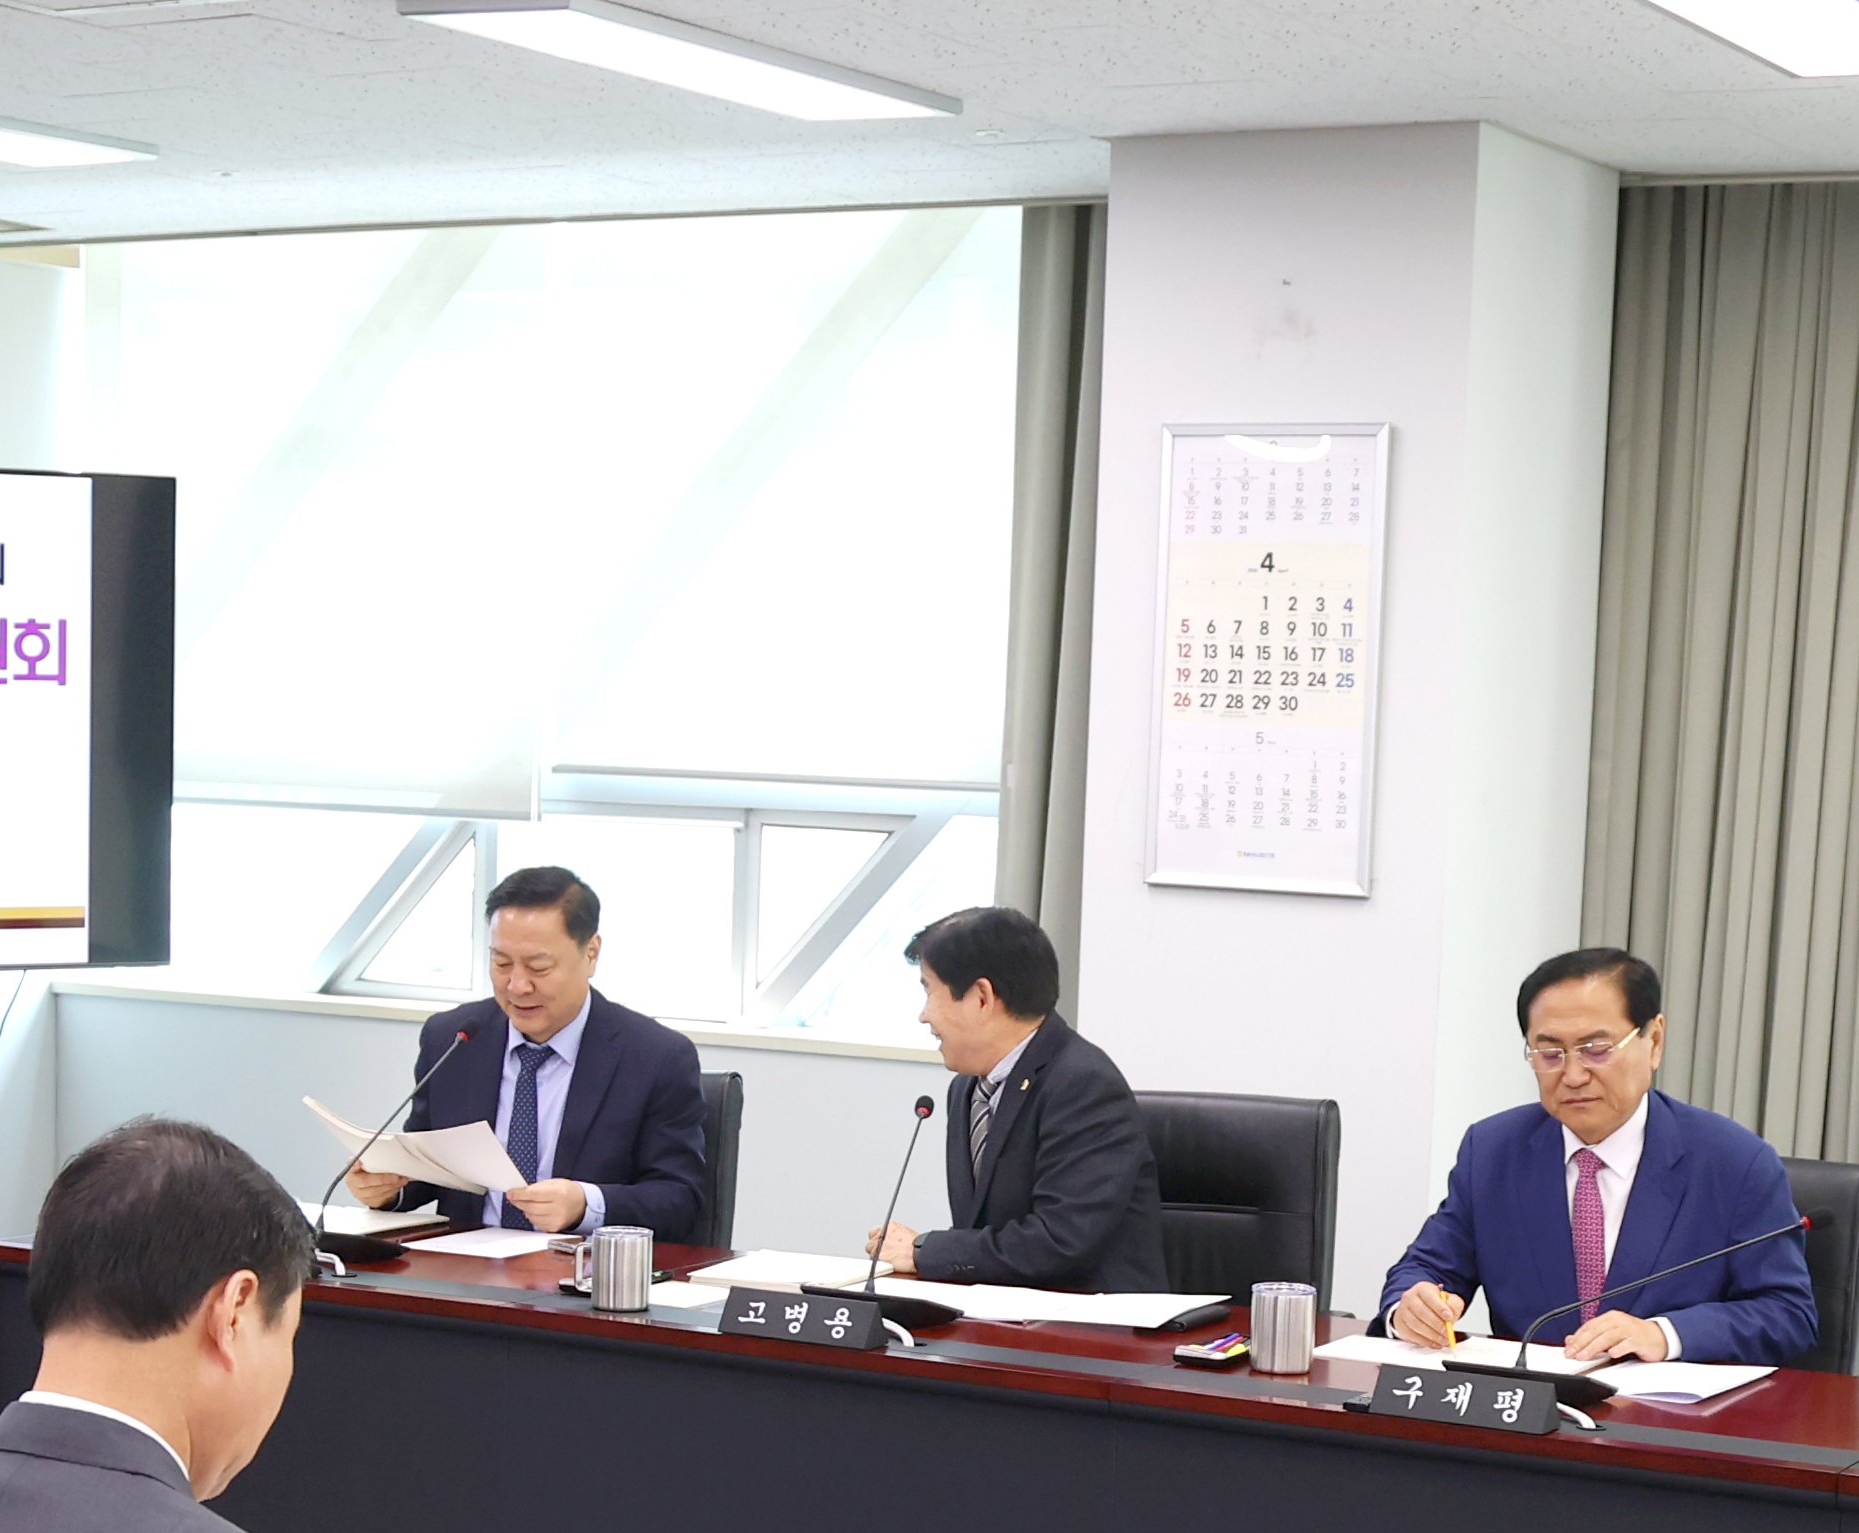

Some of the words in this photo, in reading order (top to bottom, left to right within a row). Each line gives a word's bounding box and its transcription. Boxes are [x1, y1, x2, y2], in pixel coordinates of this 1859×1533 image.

[1191, 468, 1194, 476] 1
[1216, 468, 1222, 476] 2
[1243, 468, 1248, 476] 3
[1270, 468, 1275, 476] 4
[1298, 468, 1303, 476] 5
[1354, 468, 1359, 476] 7
[1189, 482, 1194, 491] 8
[1216, 482, 1221, 491] 9
[1242, 482, 1250, 491] 10
[1270, 482, 1275, 490] 11
[1296, 483, 1303, 491] 12
[1324, 483, 1332, 491] 13
[1352, 483, 1360, 491] 14
[1188, 496, 1195, 505] 15
[1214, 496, 1221, 505] 16
[1241, 497, 1248, 505] 17
[1268, 497, 1275, 505] 18
[1296, 497, 1303, 505] 19
[1321, 497, 1332, 506] 20
[1350, 497, 1359, 506] 21
[1185, 511, 1195, 519] 22
[1212, 511, 1222, 520] 23
[1238, 511, 1248, 519] 24
[1266, 512, 1276, 520] 25
[1293, 512, 1303, 520] 26
[1321, 512, 1331, 520] 27
[1349, 512, 1359, 521] 28
[1185, 525, 1195, 534] 29
[1211, 525, 1221, 534] 30
[1239, 526, 1247, 534] 31
[1260, 552, 1275, 572] 4
[1263, 596, 1268, 610] 1
[1288, 596, 1297, 611] 2
[1316, 597, 1325, 612] 3
[1344, 598, 1353, 612] 4
[1181, 619, 1190, 633] 5
[1207, 620, 1215, 634] 6
[1234, 620, 1242, 634] 7
[1260, 621, 1269, 635] 8
[1287, 621, 1296, 635] 9
[1312, 622, 1327, 636] 10
[1341, 623, 1352, 637] 11
[1177, 644, 1192, 657] 12
[1203, 644, 1217, 658] 13
[1230, 645, 1244, 659] 14
[1256, 646, 1271, 660] 15
[1283, 646, 1298, 661] 16
[1312, 648, 1326, 661] 17
[1339, 648, 1354, 663] 18
[1176, 668, 1191, 682] 19
[1200, 669, 1218, 683] 20
[1228, 670, 1242, 684] 21
[1254, 670, 1272, 685] 22
[1280, 671, 1298, 686] 23
[1307, 673, 1326, 686] 24
[1336, 673, 1354, 687] 25
[1173, 693, 1191, 707] 26
[1199, 694, 1217, 708] 27
[1225, 694, 1243, 709] 28
[1252, 695, 1271, 710] 29
[1279, 697, 1298, 711] 30
[1255, 732, 1264, 744] 5
[1313, 761, 1316, 769] 1
[1340, 762, 1346, 770] 2
[1177, 769, 1182, 777] 3
[1203, 770, 1208, 778] 4
[1230, 772, 1235, 780] 5
[1257, 773, 1262, 781] 6
[1284, 774, 1289, 782] 7
[1312, 775, 1317, 783] 8
[1340, 776, 1345, 784] 9
[1175, 783, 1183, 792] 10
[1229, 786, 1236, 794] 12
[1255, 787, 1263, 796] 13
[1283, 788, 1290, 796] 14
[1311, 790, 1318, 798] 15
[1338, 791, 1346, 799] 16
[1202, 799, 1209, 808] 18
[1228, 800, 1235, 808] 19
[1253, 801, 1263, 810] 20
[1281, 803, 1289, 811] 21
[1308, 804, 1318, 813] 22
[1336, 805, 1346, 814] 23
[1199, 813, 1209, 821] 25
[1226, 814, 1236, 823] 26
[1253, 815, 1263, 824] 27
[1280, 817, 1290, 826] 28
[1307, 818, 1318, 827] 29
[1335, 820, 1346, 828] 30
